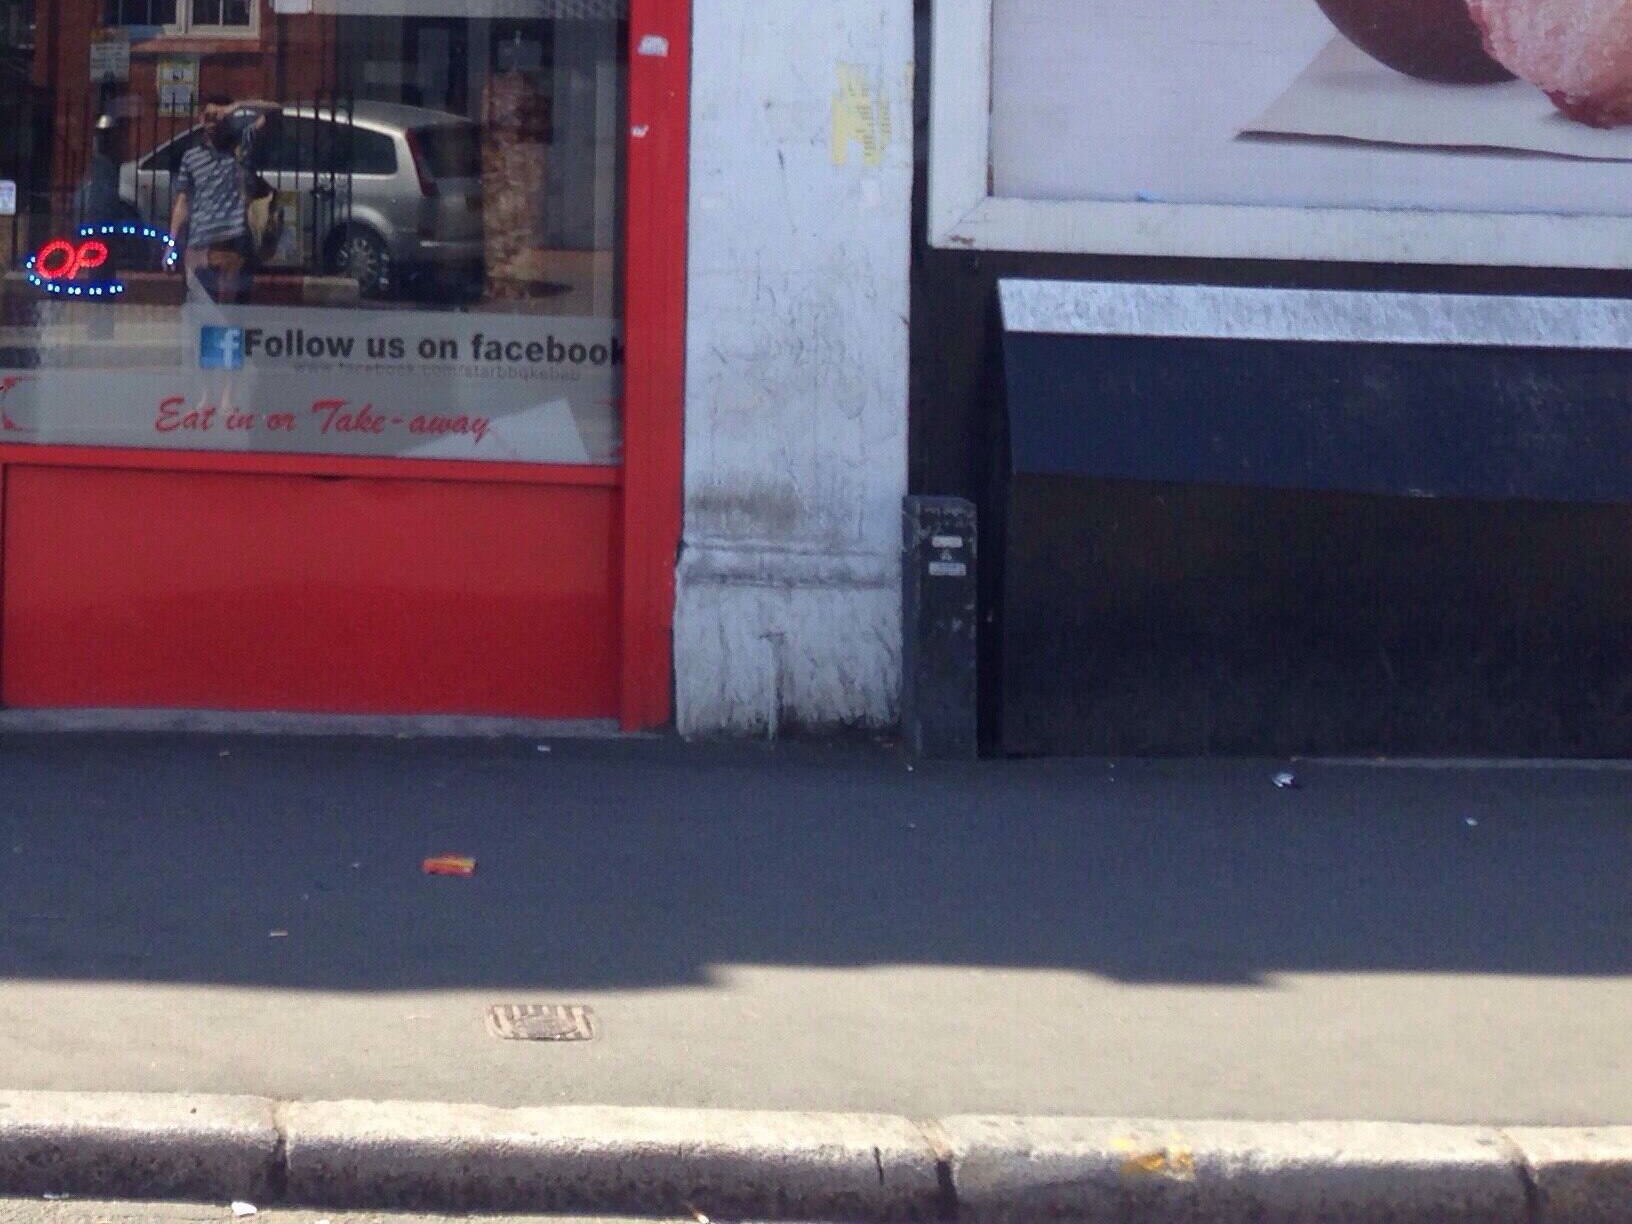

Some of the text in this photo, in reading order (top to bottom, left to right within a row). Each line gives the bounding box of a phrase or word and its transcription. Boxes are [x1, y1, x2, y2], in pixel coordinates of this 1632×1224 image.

[244, 327, 358, 360] Follow
[366, 335, 406, 360] us
[418, 337, 460, 362] on
[155, 397, 491, 440] Eat in or Take-away
